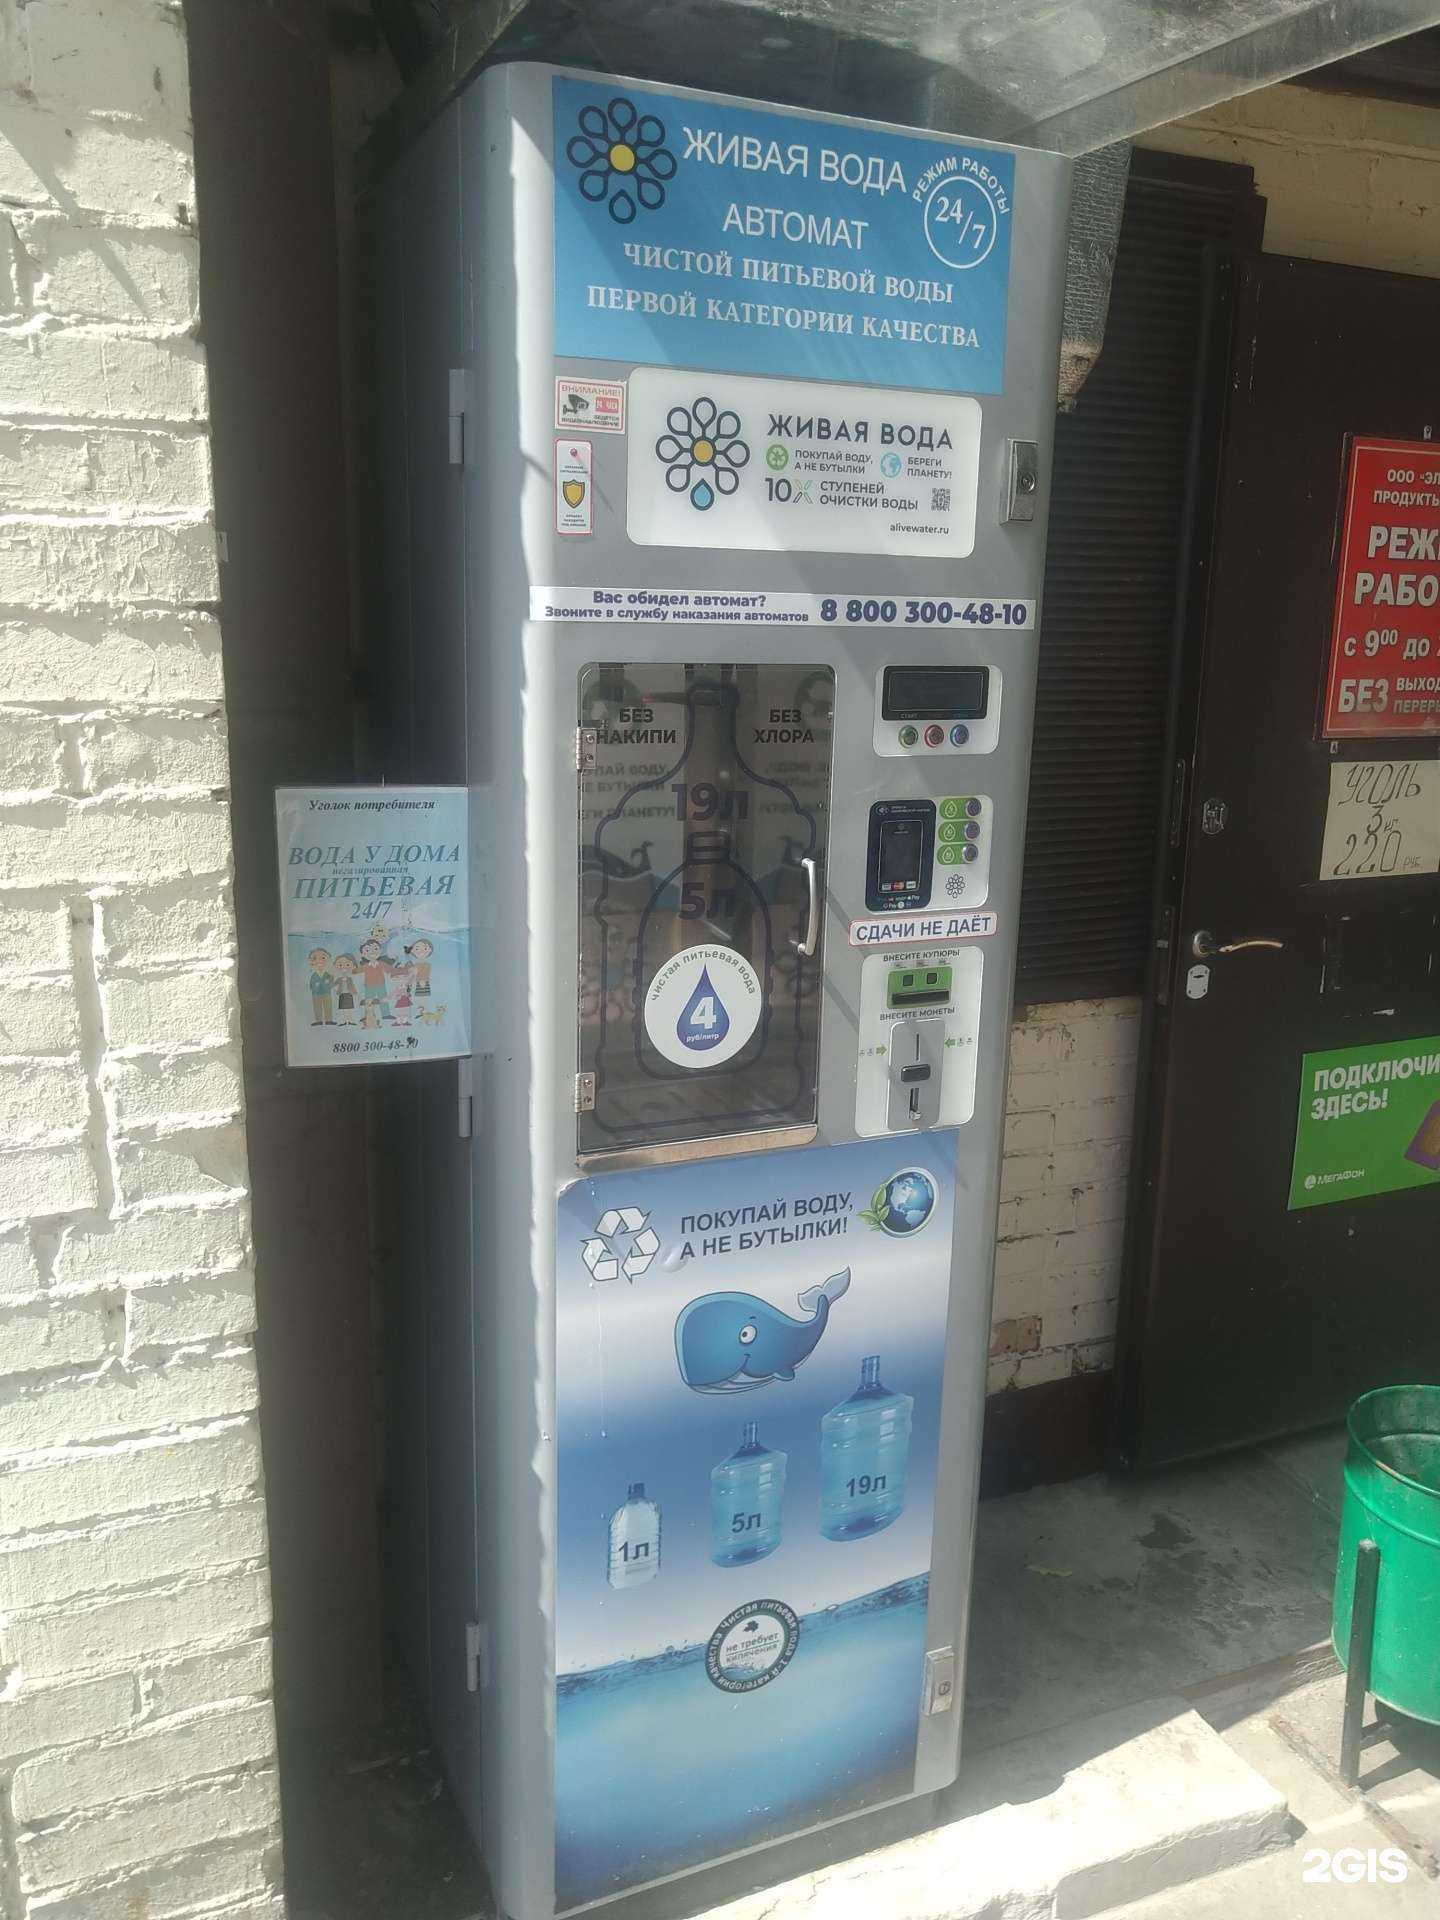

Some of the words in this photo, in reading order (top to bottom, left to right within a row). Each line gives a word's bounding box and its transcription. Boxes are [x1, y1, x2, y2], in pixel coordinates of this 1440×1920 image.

[682, 127, 808, 177] ЖИВАЯ
[820, 150, 906, 196] ВОДА
[913, 156, 959, 202] РЕЖИМ
[962, 157, 1010, 215] РАБОТЫ
[723, 203, 868, 250] АВТОМАТ
[935, 196, 986, 250] 24/7
[623, 243, 733, 277] ЧИСТОЙ
[743, 258, 875, 294] ПИТЬЕВОЙ
[885, 276, 953, 303] ВОДЫ
[587, 286, 697, 318] ПЕРВОЙ
[707, 299, 853, 334] КАТЕГОРИИ
[863, 317, 980, 348] КАЧЕСТВА
[767, 413, 869, 443] ЖИВАЯ
[880, 423, 953, 452] ВОДА
[795, 449, 842, 462] ПОКУПАЙ
[845, 452, 873, 464] ВОДУ,
[907, 456, 942, 467] БЕРЕГИ
[795, 462, 801, 471] А
[804, 463, 817, 472] НЕ
[819, 463, 865, 475] БУТЫЛКИ
[907, 468, 952, 480] ПЛАНЕТУ!
[1387, 469, 1415, 483] ООО
[820, 480, 885, 495] СТУПЕНЕЙ
[820, 494, 878, 509] ОЧИСТКИ
[881, 497, 919, 511] ВОДЫ
[889, 522, 950, 535] alivewater.ru
[1368, 525, 1440, 560] РЕЖ
[593, 590, 622, 604] Вас
[627, 591, 690, 606] обидел
[694, 594, 767, 607] автомат?
[545, 606, 602, 618] Звоните
[606, 610, 613, 618] в
[617, 607, 669, 622] службу
[672, 611, 741, 621] наказания
[744, 611, 809, 622] автоматов
[820, 598, 838, 622] 8
[846, 599, 897, 623] 800
[905, 601, 1027, 625] 300-48-10
[1338, 679, 1389, 712] БЕЗ
[619, 708, 654, 724] БЕЗ
[769, 708, 802, 724] БЕЗ
[596, 729, 676, 745] НАКИПИ
[753, 729, 815, 745] ХЛОРА
[309, 800, 351, 811] Уголок
[354, 799, 435, 811] потребителя
[1367, 805, 1384, 833] 3
[288, 846, 355, 867] ВОДА
[365, 845, 383, 864] У
[384, 844, 460, 867] ДОМА
[1334, 831, 1401, 875] 220
[292, 874, 455, 899] ПИТЬЕВАЯ
[351, 901, 393, 920] 24/7
[856, 922, 915, 942] СДАЧИ
[920, 920, 942, 936] НЕ
[947, 915, 991, 937] ДАЁТ
[883, 952, 920, 962] ВНЕСИТЕ
[923, 949, 960, 959] КУПЮРЫ
[652, 962, 681, 1001] чистая
[683, 950, 739, 967] питьевая
[738, 965, 756, 994] вода
[690, 996, 717, 1029] 4
[880, 1010, 917, 1021] ВНЕСИТЕ
[920, 1007, 955, 1017] МОНЕТЫ
[333, 1042, 360, 1053] 8800
[1311, 1088, 1388, 1120] ЗДЕСЬ!
[681, 1198, 786, 1235] ПОКУПАЙ
[794, 1192, 853, 1218] ВОДУ,
[680, 1242, 695, 1260] А
[703, 1236, 731, 1257] НЕ
[739, 1217, 847, 1250] БУТЫЛКИ!
[846, 1473, 886, 1498] 19л
[731, 1511, 762, 1534] 5л
[618, 1541, 649, 1562] 1л
[726, 1643, 738, 1652] не
[741, 1632, 779, 1648] требует
